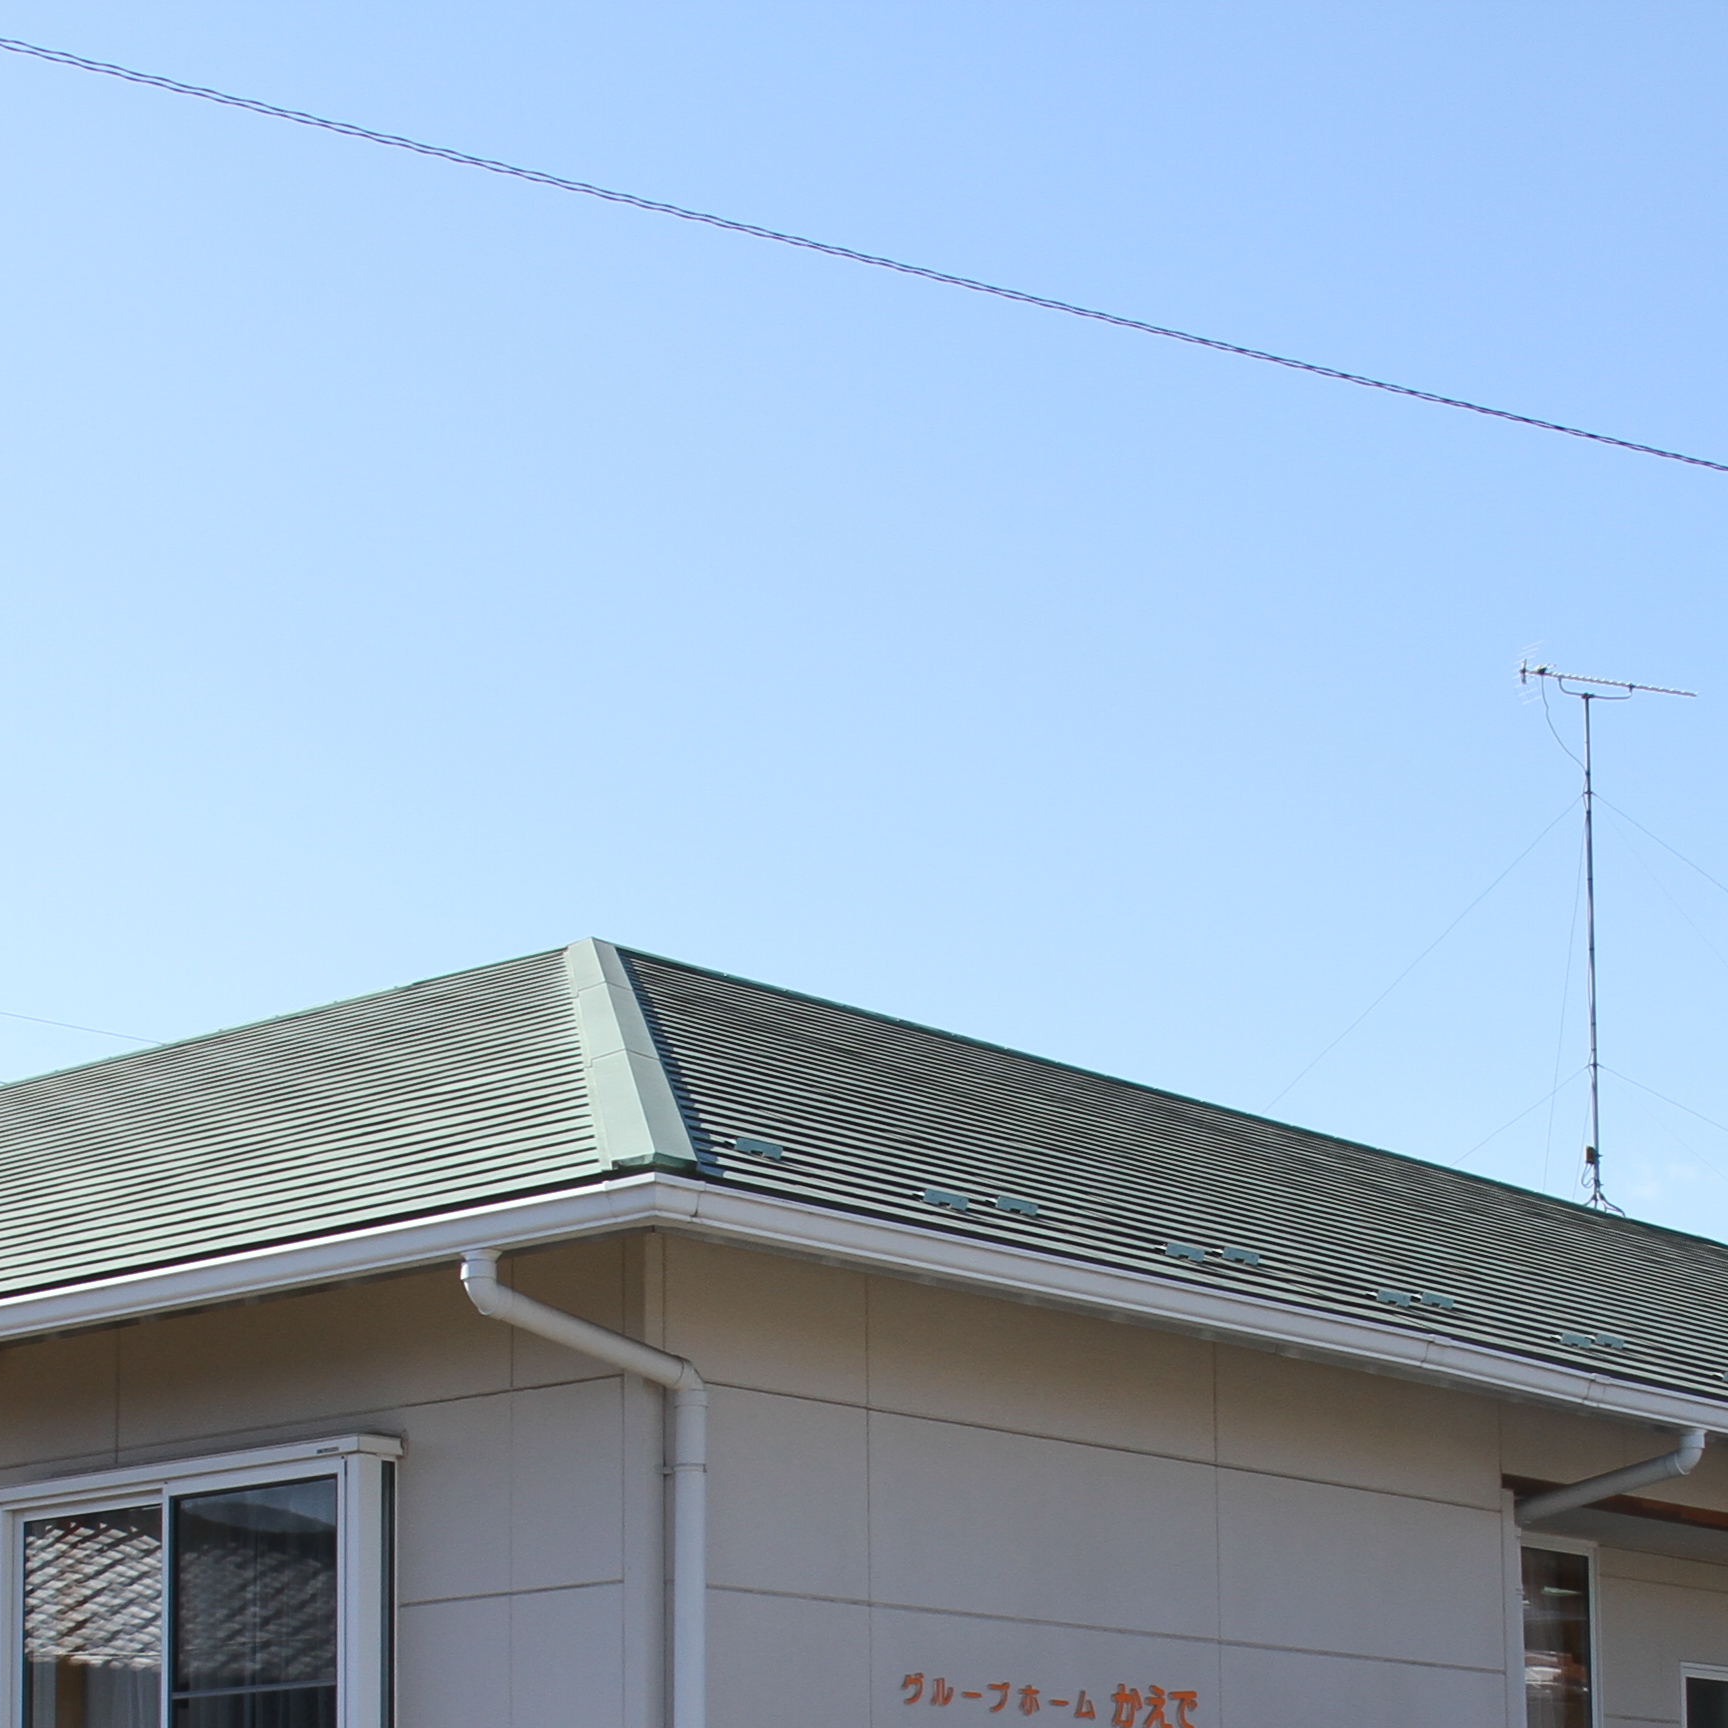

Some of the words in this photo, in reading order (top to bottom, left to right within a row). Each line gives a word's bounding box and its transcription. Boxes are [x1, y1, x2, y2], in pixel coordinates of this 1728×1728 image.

[901, 1672, 1097, 1720] グループホーム
